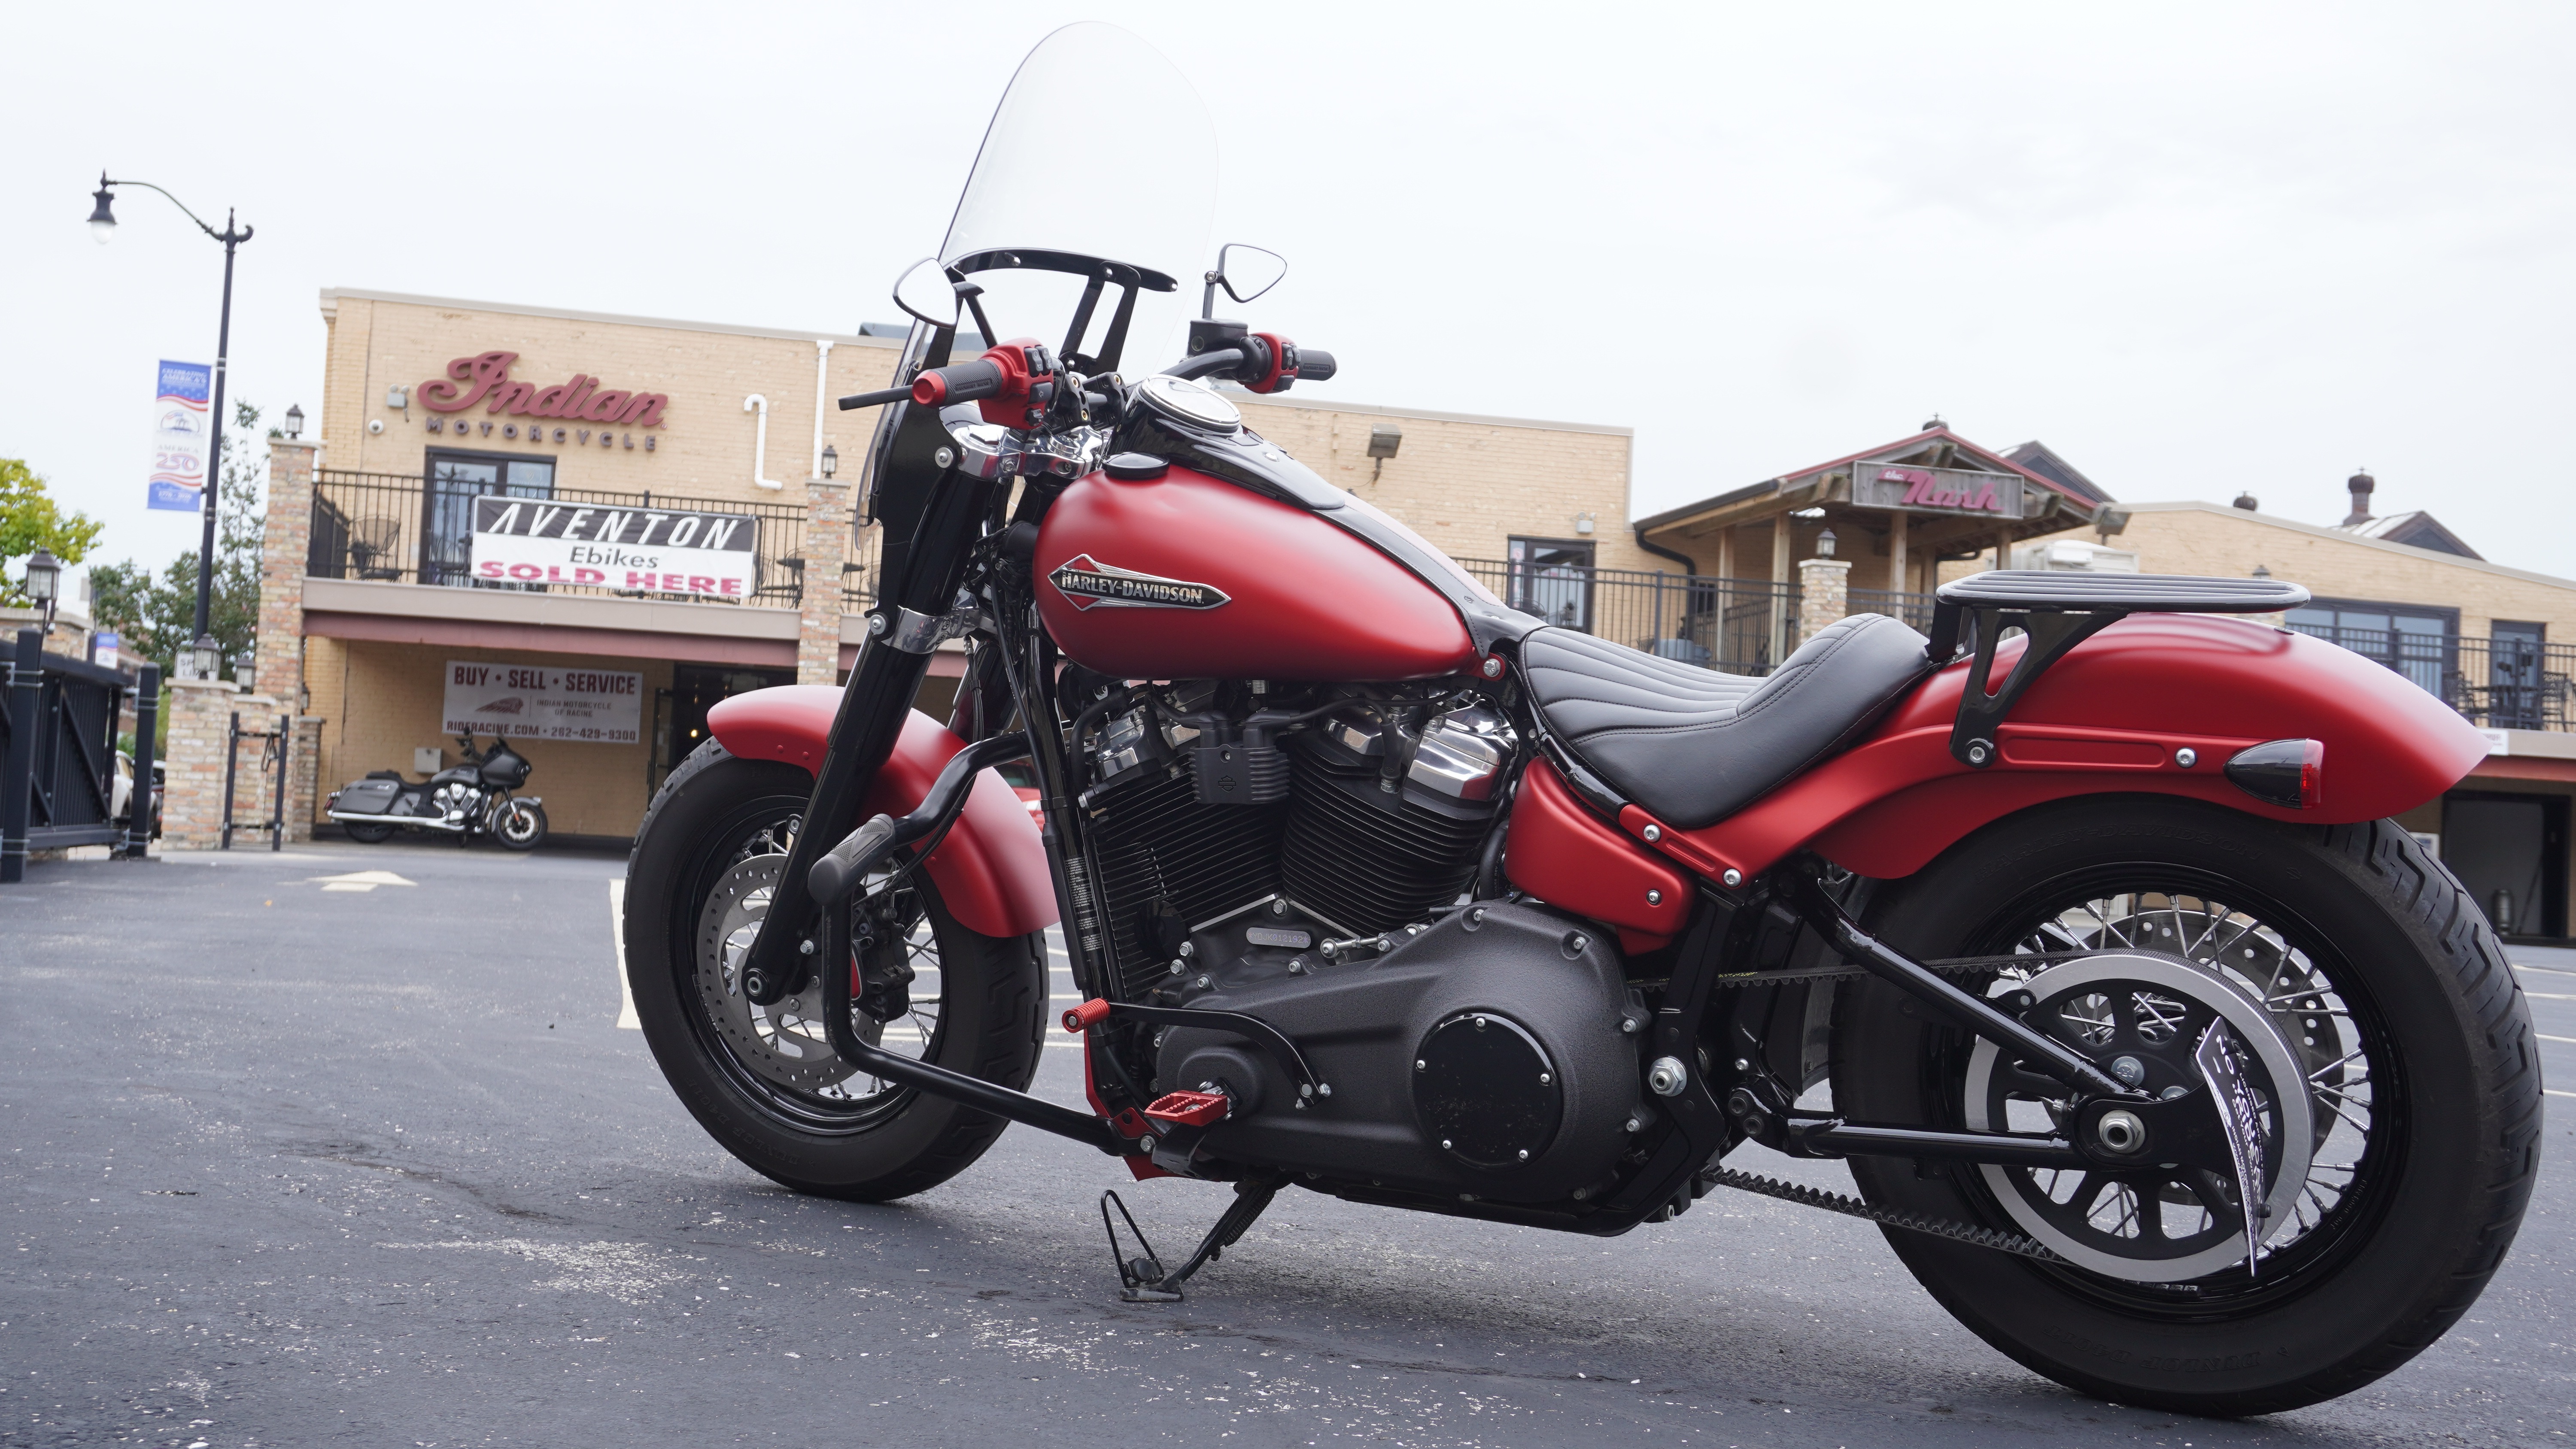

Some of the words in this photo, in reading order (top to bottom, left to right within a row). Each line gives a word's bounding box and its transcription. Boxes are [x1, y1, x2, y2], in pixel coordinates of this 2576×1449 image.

[416, 350, 668, 426] Indian
[157, 444, 199, 453] AMERICA
[425, 416, 656, 451] MOTORCYCLE
[155, 452, 200, 471] 250
[1884, 470, 1905, 480] the
[488, 503, 738, 550] AVENTON
[569, 546, 659, 569] Ebikes
[479, 561, 606, 584] SOLD
[626, 571, 742, 596] HERE
[1061, 572, 1203, 603] HARLEY-DAVIDSON
[454, 666, 489, 686] BUY
[508, 669, 546, 690] SELL
[565, 672, 636, 695] SERVICE
[537, 699, 561, 707] INDIAN
[563, 700, 611, 710] MOTORCYCLE
[447, 720, 539, 736] RIDERACINE.COM
[551, 727, 636, 741] 262-429-9300
[1974, 823, 2266, 885] HARLEY-DAVIDSON
[2216, 1034, 2234, 1075] NO
[2237, 1079, 2256, 1137] YOU
[2239, 1072, 2256, 1119] LICENSED
[732, 1126, 802, 1165] DUNLOP
[2232, 1126, 2242, 1155] INDIAN
[2042, 1325, 2132, 1364] D401T
[2140, 1351, 2262, 1372] DUNLOP
